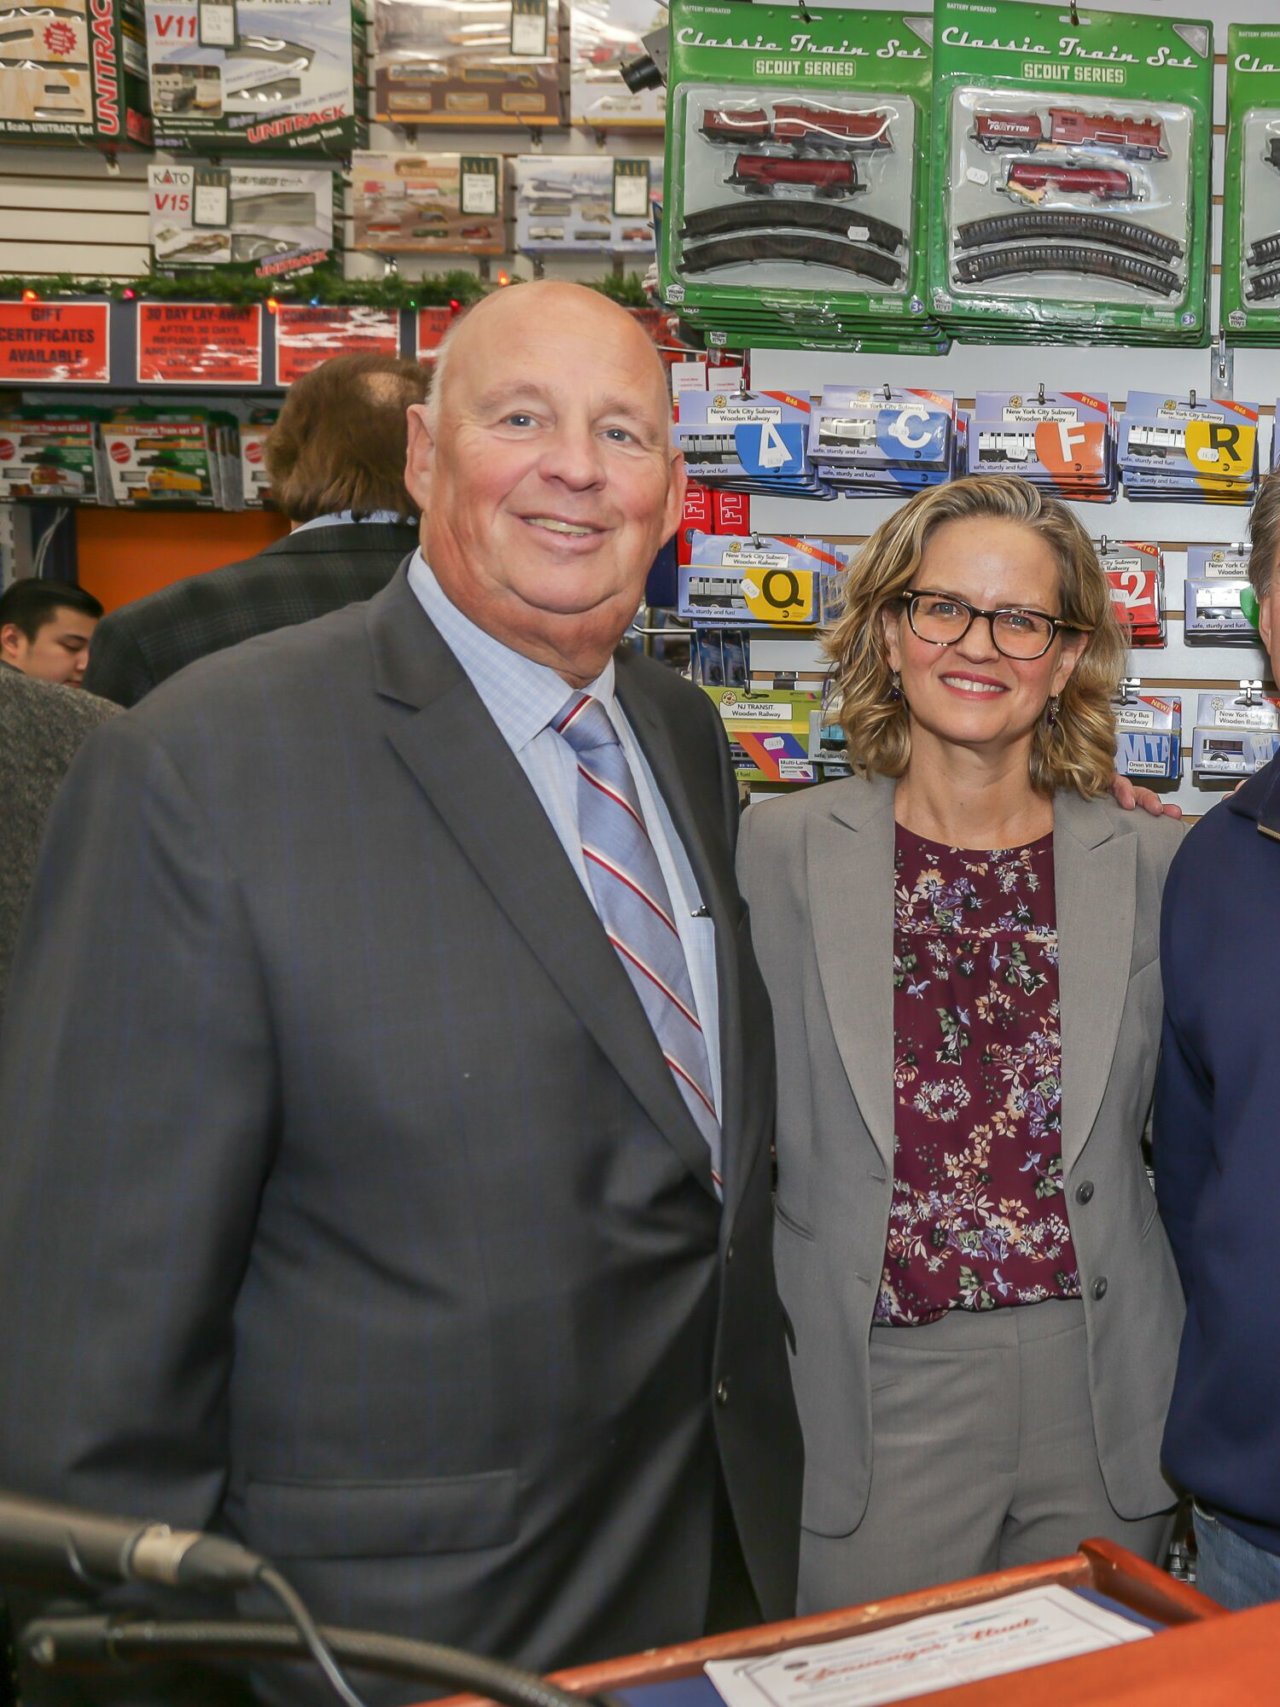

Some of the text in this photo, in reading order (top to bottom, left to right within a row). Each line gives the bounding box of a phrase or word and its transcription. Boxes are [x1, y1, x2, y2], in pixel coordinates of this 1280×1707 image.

[947, 3, 997, 13] BATTERY OPERATED
[154, 15, 197, 38] V11
[676, 28, 928, 59] Classic Train Set
[941, 26, 1198, 69] Classic Train Set
[756, 60, 854, 77] SCOUT SERIES
[1024, 63, 1125, 84] SCOUT SERIES
[7, 121, 31, 132] Scale
[32, 122, 77, 134] UNITRACK
[79, 125, 94, 135] Set
[246, 104, 347, 144] UNITRACK
[153, 169, 191, 185] KATO
[154, 194, 190, 212] V15
[31, 307, 64, 322] GIFT
[165, 308, 190, 321] DAY
[0, 327, 95, 343] CERTIFICATES
[9, 349, 83, 364] AVAILABLE
[1082, 396, 1098, 407] R160
[1052, 409, 1075, 417] Subway
[1189, 411, 1201, 419] City
[1201, 413, 1223, 421] Subway
[896, 408, 932, 449] C
[758, 423, 793, 467] A
[1057, 421, 1086, 463] F
[1209, 423, 1242, 461] R
[758, 559, 779, 567] Railway
[1101, 559, 1113, 567] City
[762, 569, 804, 609] Q
[1121, 571, 1151, 609] 2
[1206, 622, 1223, 630] sturdy
[1151, 699, 1170, 713] NEW!
[1121, 718, 1149, 726] Roadway
[1124, 711, 1137, 719] City
[1219, 717, 1245, 725] Wooden
